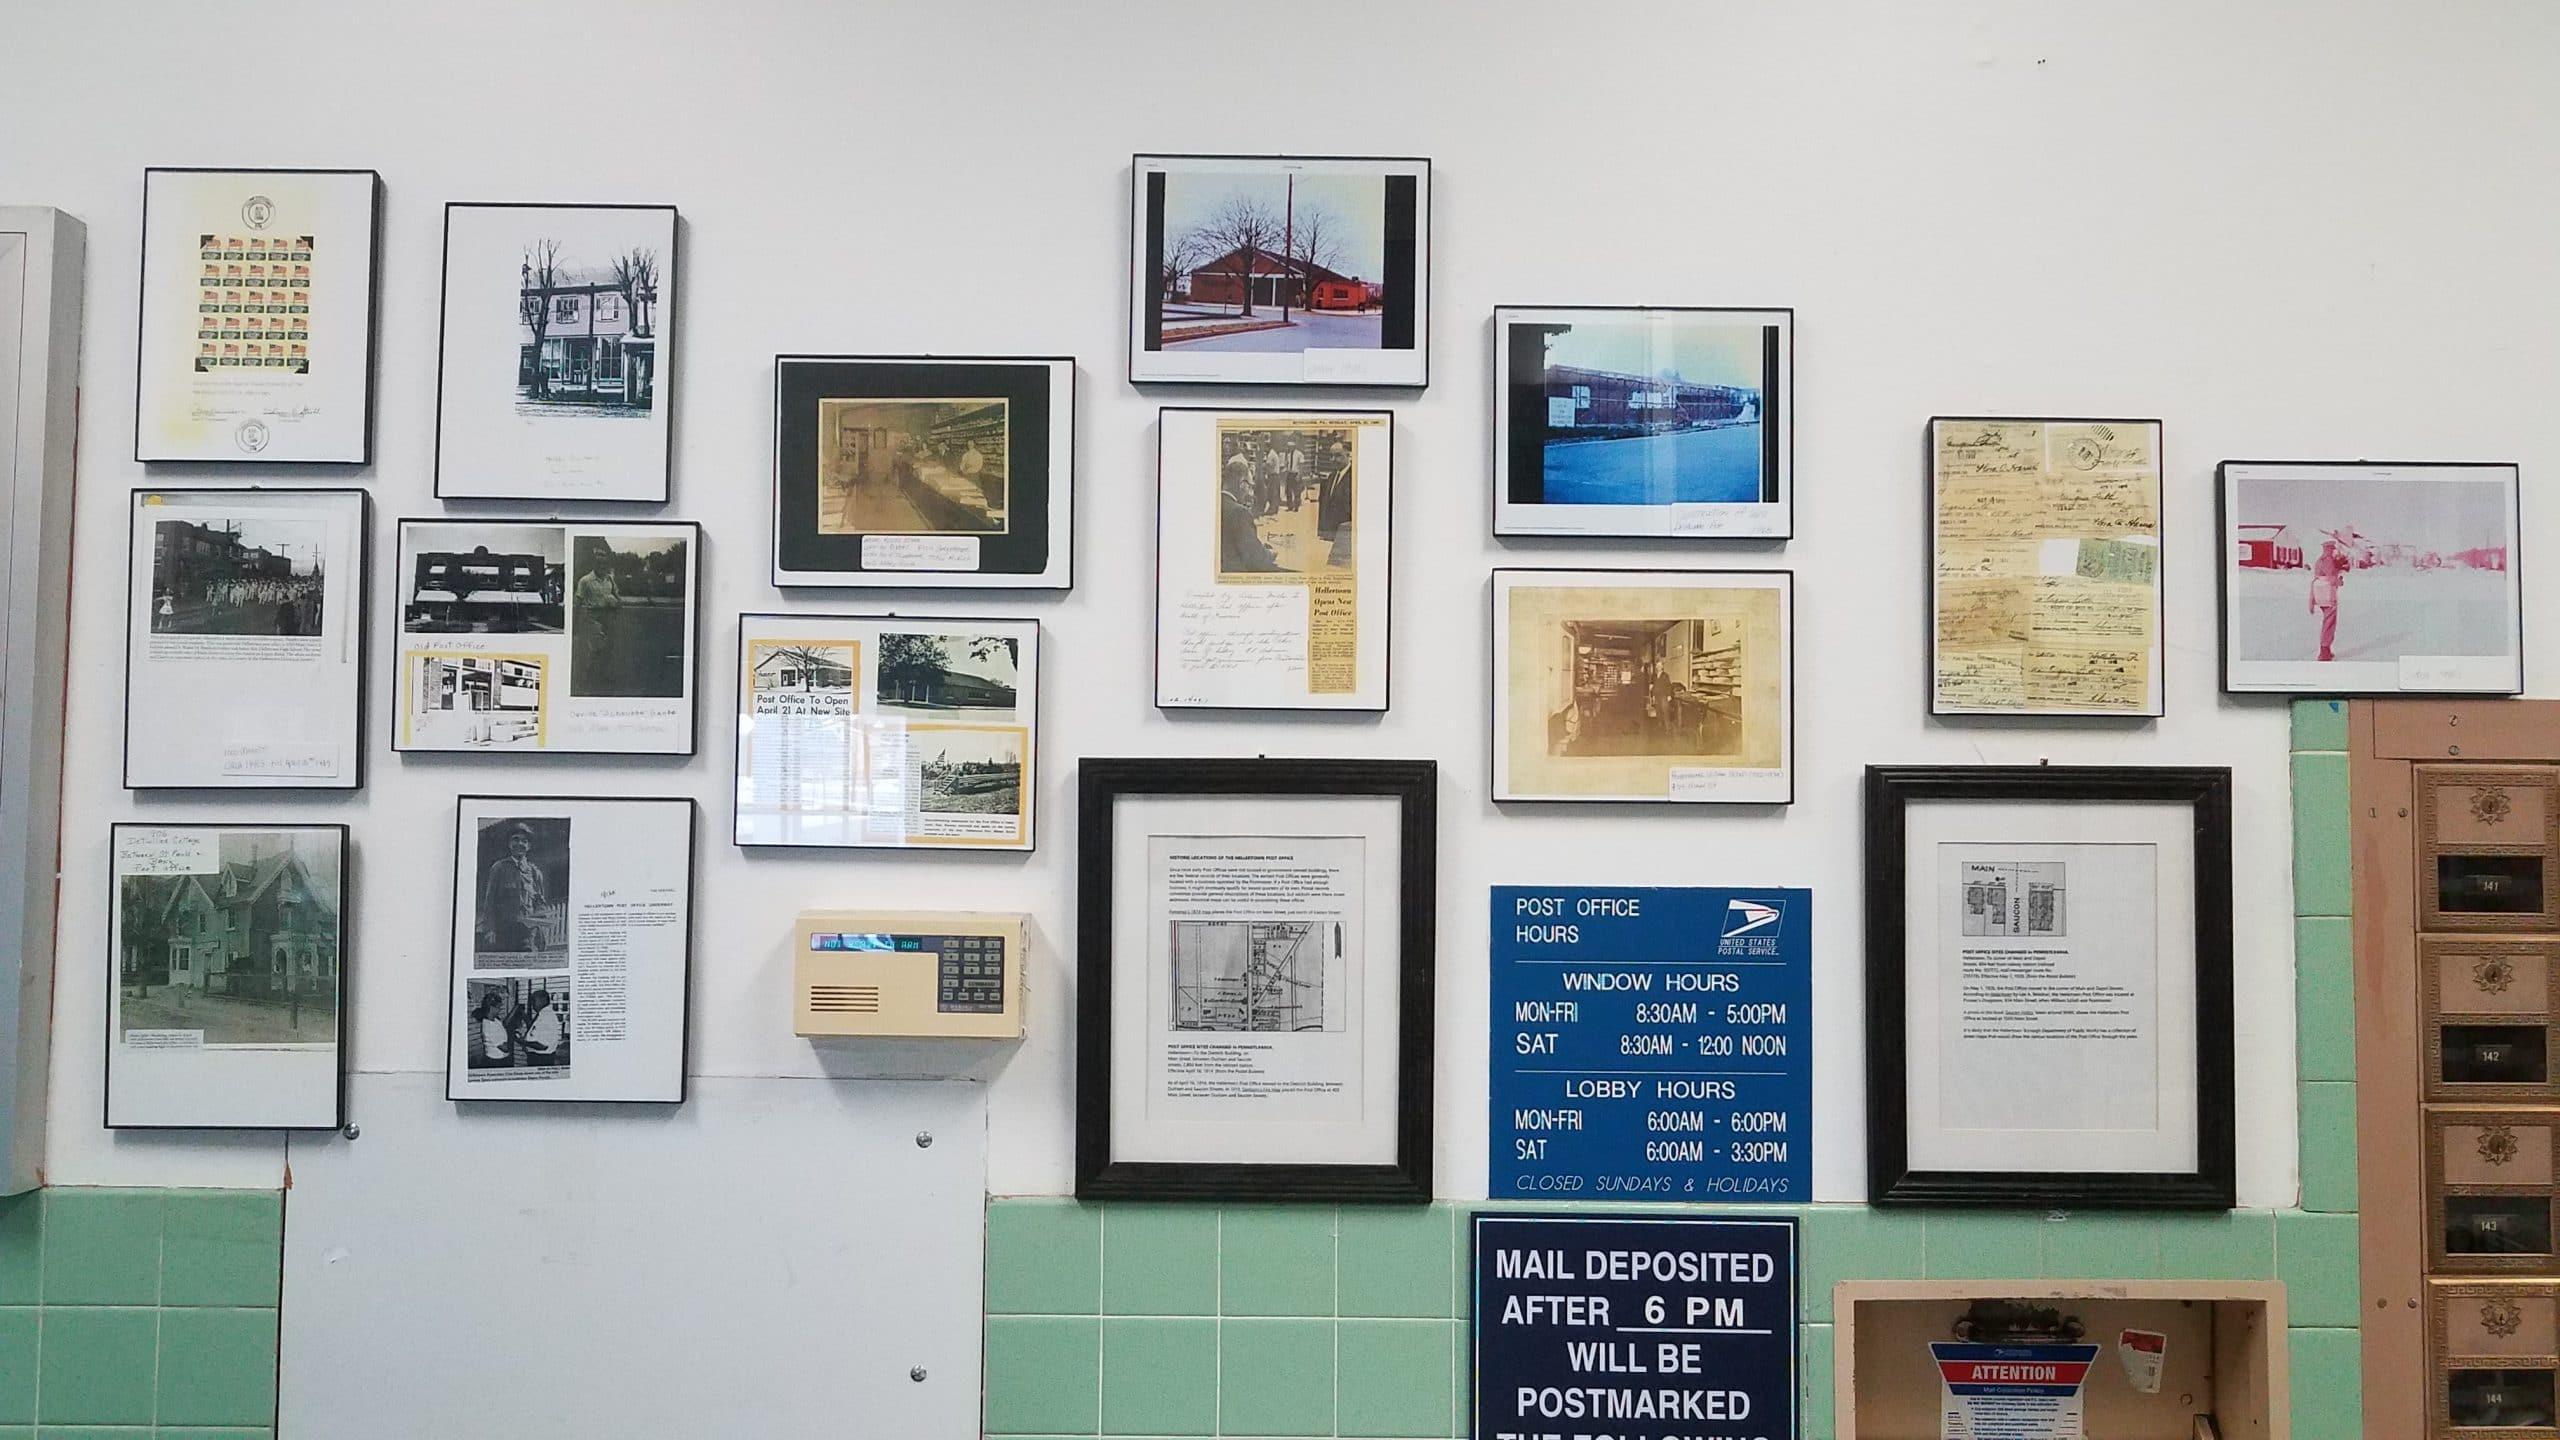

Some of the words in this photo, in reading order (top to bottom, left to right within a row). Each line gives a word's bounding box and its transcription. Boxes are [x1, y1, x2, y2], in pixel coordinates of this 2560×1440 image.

[757, 695, 775, 703] Post
[779, 695, 805, 703] Office
[825, 696, 848, 707] Open
[757, 706, 777, 714] April
[2484, 881, 2498, 891] 141
[1517, 898, 1565, 916] POST
[1577, 899, 1639, 916] OFFICE
[1517, 925, 1578, 943] HOURS
[1719, 938, 1745, 946] UNITED
[1748, 938, 1777, 946] STATES
[1718, 947, 1744, 955] POSTAL
[1563, 973, 1652, 990] WINDOW
[1666, 974, 1739, 992] HOURS
[1516, 1002, 1577, 1022] MON-FRI
[1637, 1003, 1696, 1023] 8:30AM
[1727, 1004, 1785, 1024] 5:00PM
[1517, 1033, 1558, 1054] SAT
[1621, 1035, 1672, 1054] 8:30AM
[1698, 1036, 1732, 1055] 12:00
[1743, 1036, 1786, 1055] NOON
[2483, 1051, 2499, 1061] 142
[1567, 1080, 1641, 1098] LOBBY
[1658, 1081, 1735, 1099] HOURS
[1516, 1110, 1582, 1130] MON-FRI
[1648, 1111, 1703, 1131] 6:00AM
[1732, 1112, 1786, 1132] 6:00PM
[1516, 1139, 1547, 1159] SAT
[1647, 1141, 1702, 1161] 6:00AM
[1732, 1142, 1786, 1162] 3:30PM
[1517, 1175, 1583, 1190] CLOSED
[1596, 1176, 1671, 1191] SUNDAYS
[1684, 1178, 1694, 1191] &
[1707, 1177, 1789, 1192] HOLIDAYS
[2481, 1222, 2496, 1231] 143
[1497, 1250, 1574, 1279] MAIL
[1587, 1251, 1773, 1282] DEPOSITED
[1502, 1296, 1609, 1325] AFTER
[1645, 1296, 1664, 1324] 6
[1687, 1297, 1743, 1326] PM
[1567, 1342, 1647, 1372] WILL
[1659, 1344, 1701, 1373] BE
[1972, 1366, 2056, 1380] ATTENTION
[1518, 1388, 1750, 1419] POSTMARKED
[2487, 1394, 2502, 1403] 144
